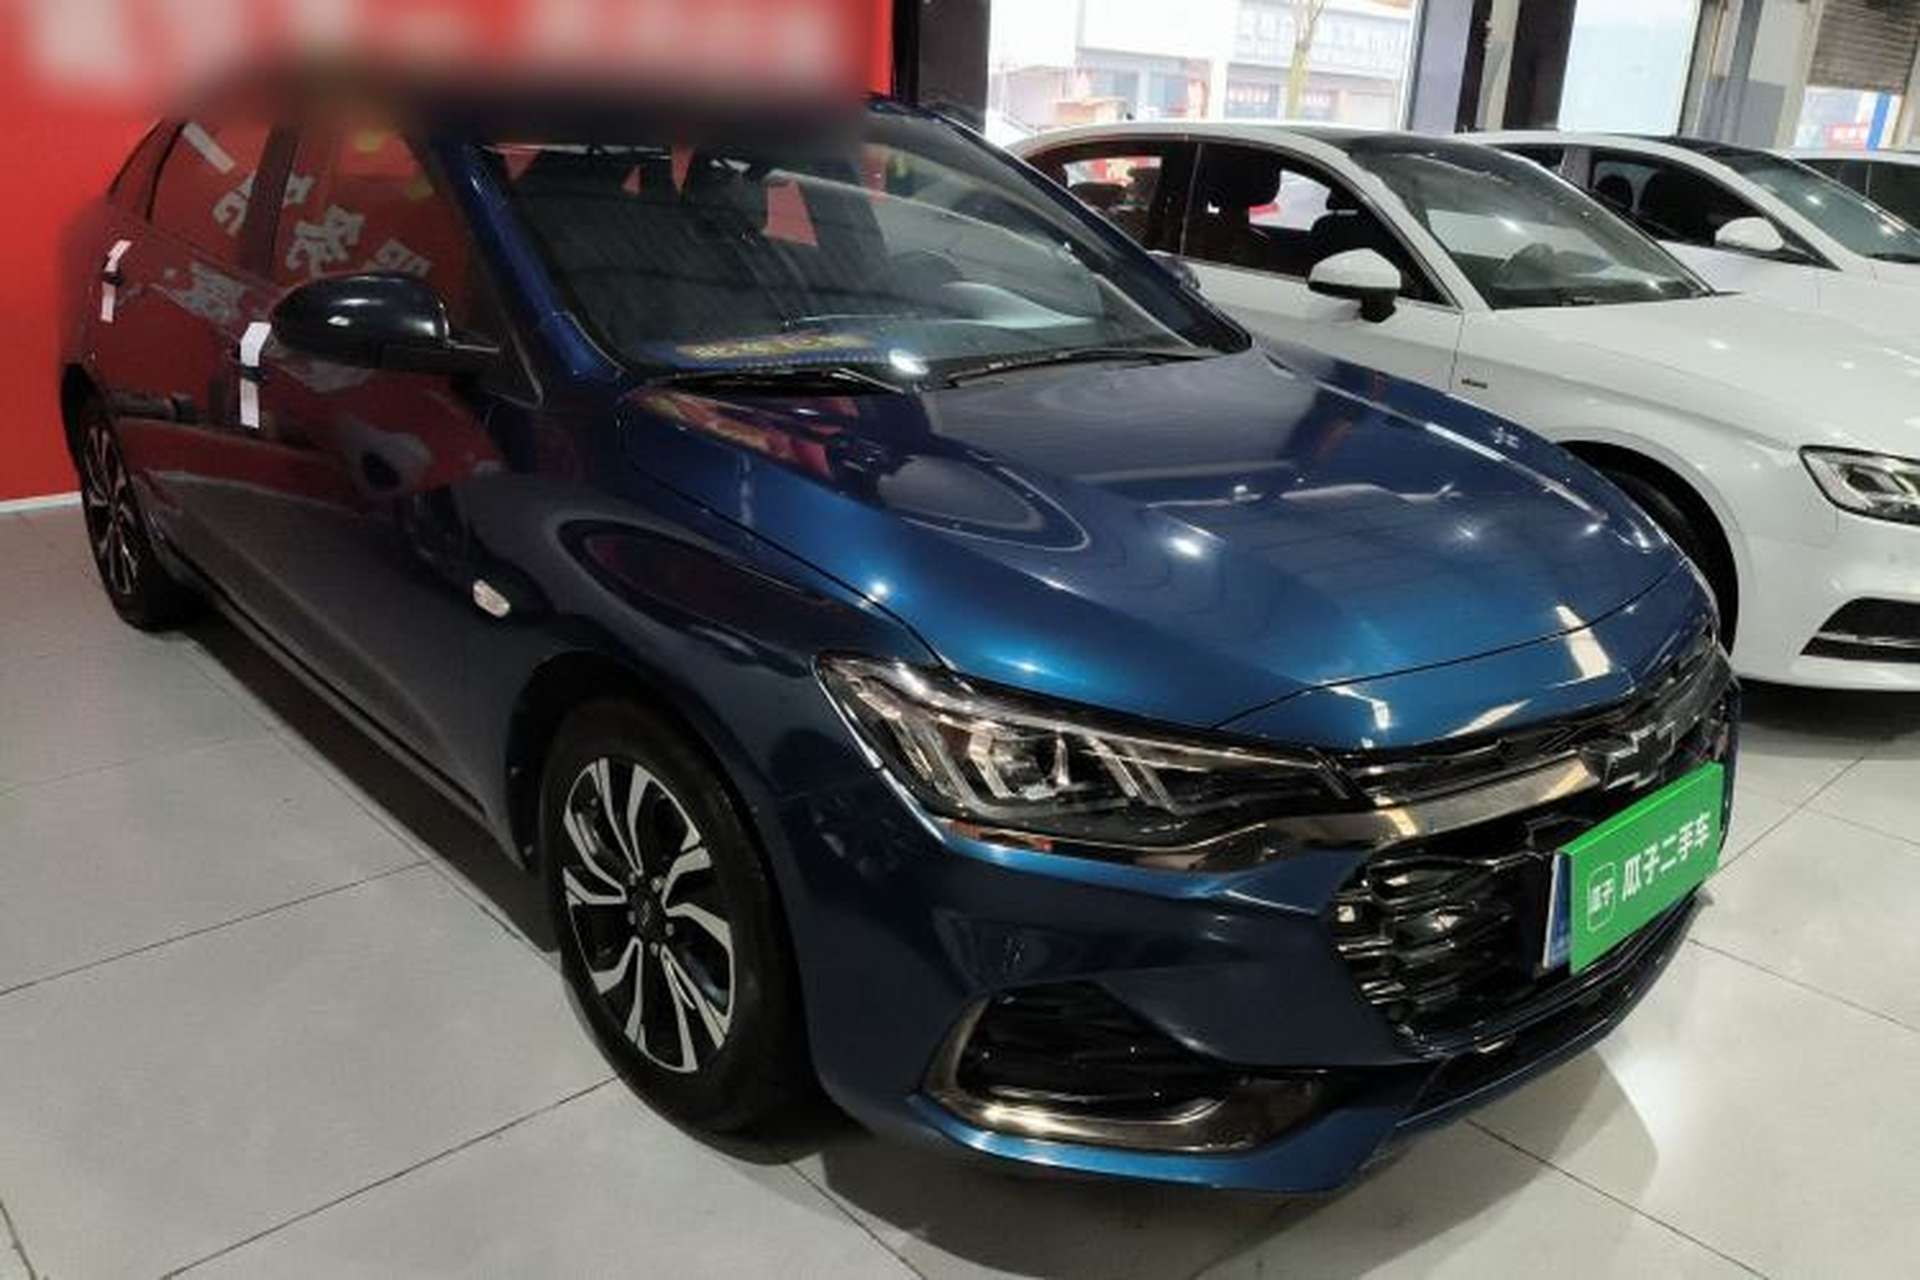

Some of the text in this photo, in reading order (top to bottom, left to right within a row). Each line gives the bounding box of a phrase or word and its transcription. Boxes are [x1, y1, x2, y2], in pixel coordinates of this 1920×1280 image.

[1621, 811, 1711, 902] 瓜子二手车
